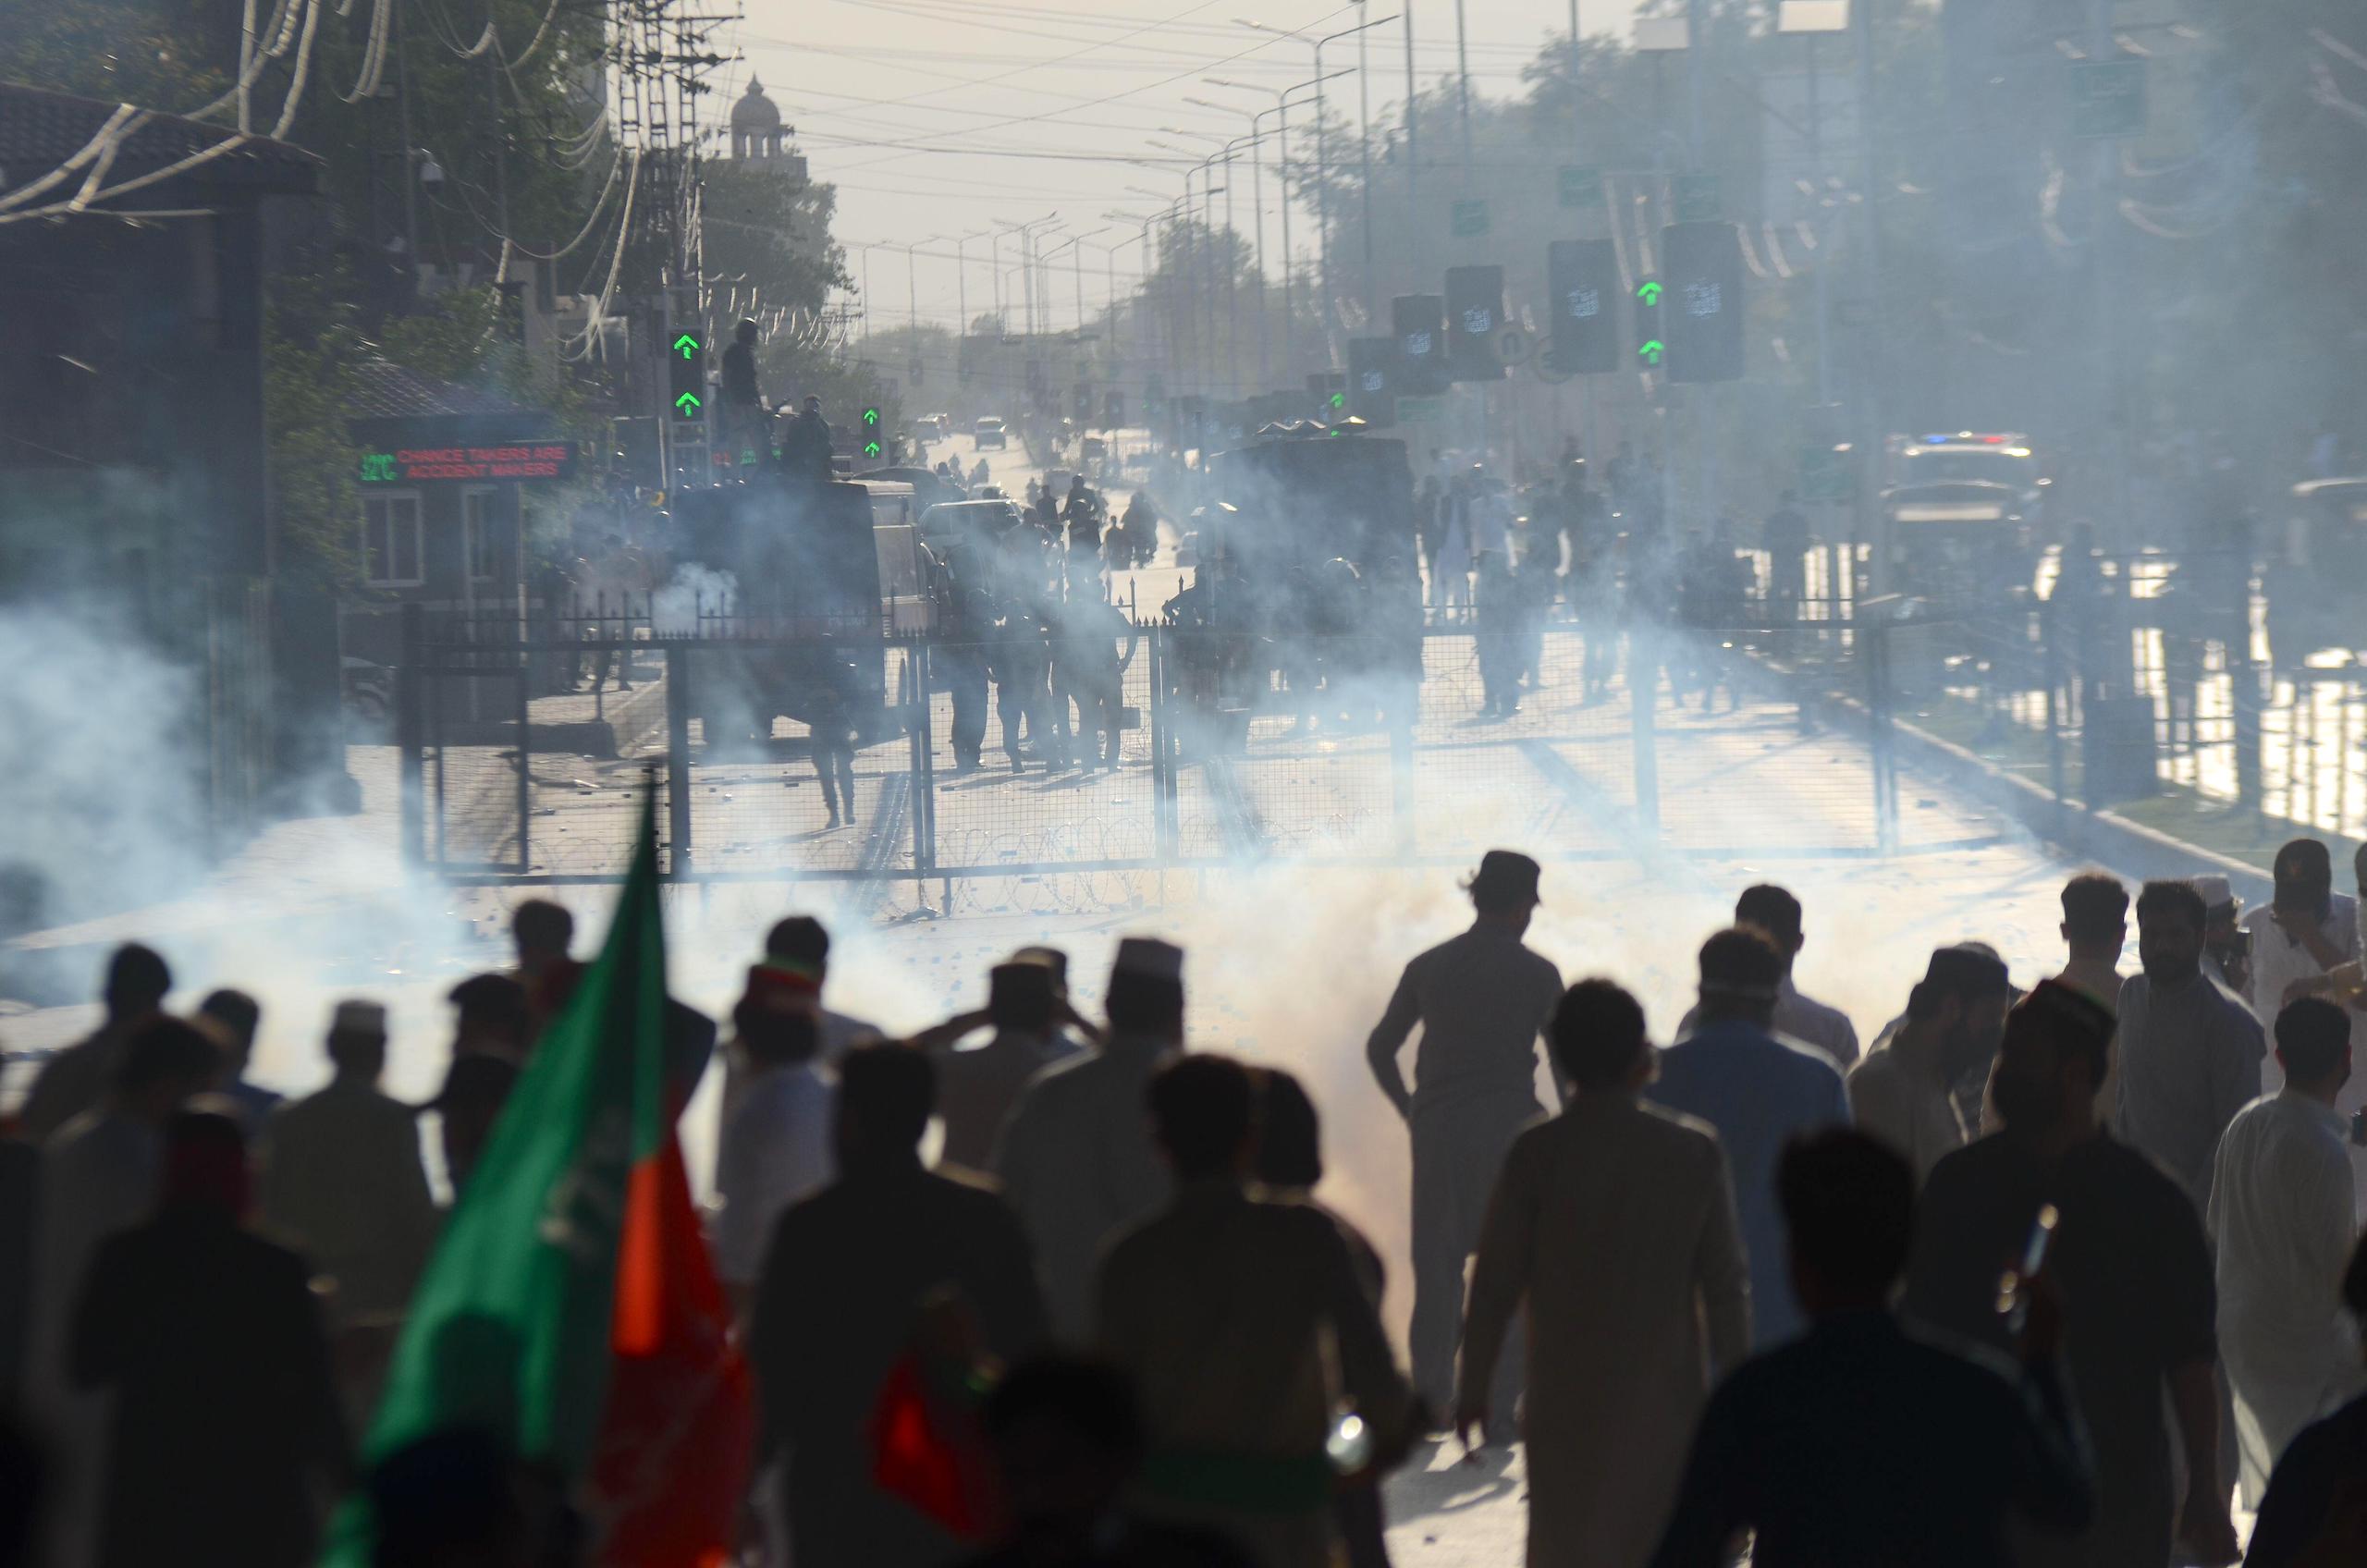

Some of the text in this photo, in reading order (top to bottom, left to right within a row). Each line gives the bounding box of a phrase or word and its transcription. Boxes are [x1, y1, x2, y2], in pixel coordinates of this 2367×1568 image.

[396, 447, 567, 463] CHANCE TAKERS ARE
[406, 462, 558, 479] ACCIDENT MAKERS
